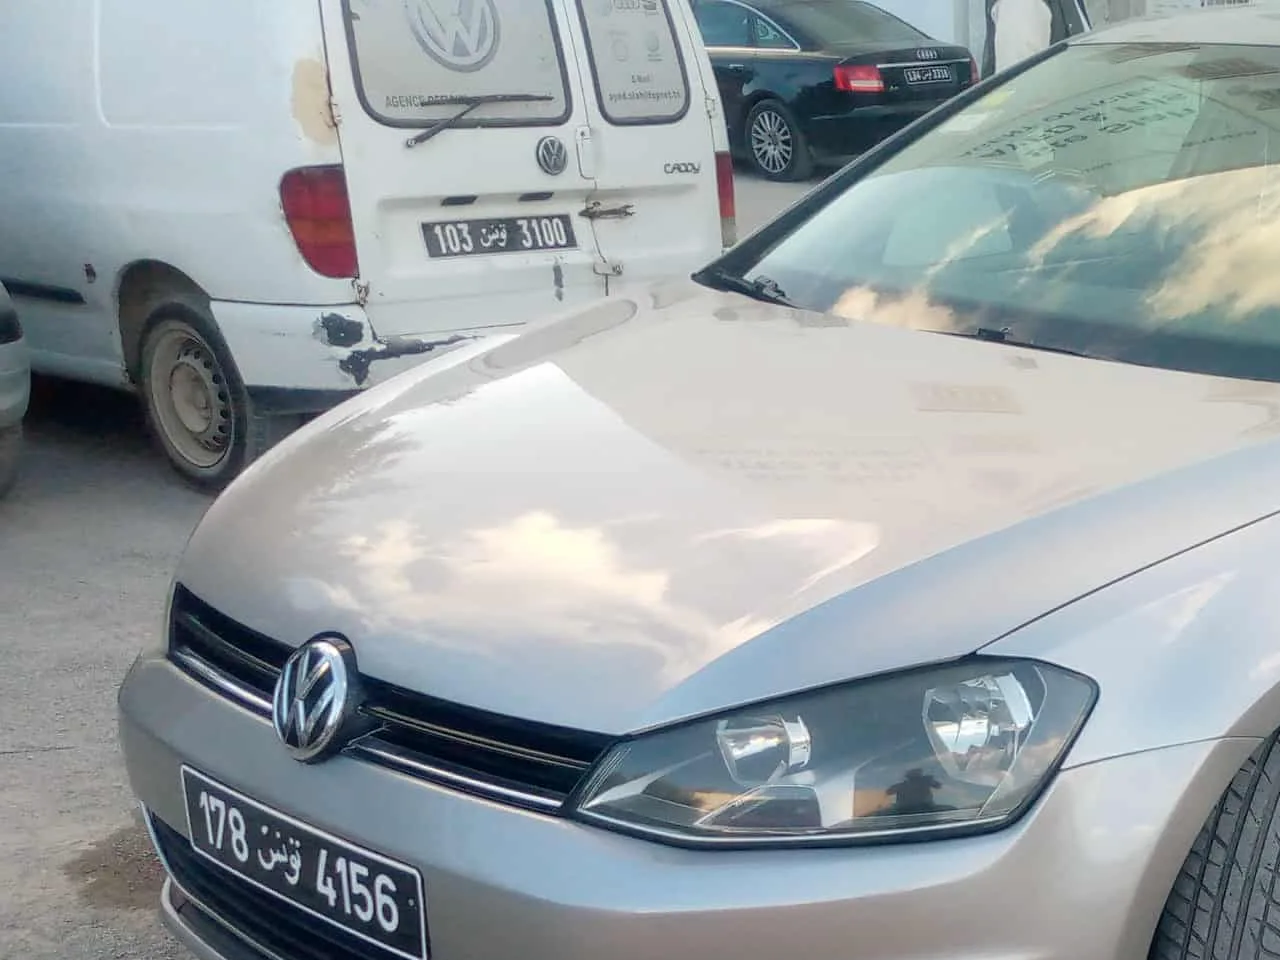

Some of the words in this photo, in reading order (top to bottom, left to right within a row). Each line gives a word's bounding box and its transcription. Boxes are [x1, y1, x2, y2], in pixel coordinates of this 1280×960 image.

[664, 162, 700, 174] CADDY
[433, 222, 474, 254] 103
[517, 217, 567, 249] 3100
[200, 791, 249, 863] 178
[257, 824, 302, 885] تونس
[316, 848, 399, 932] 4156
